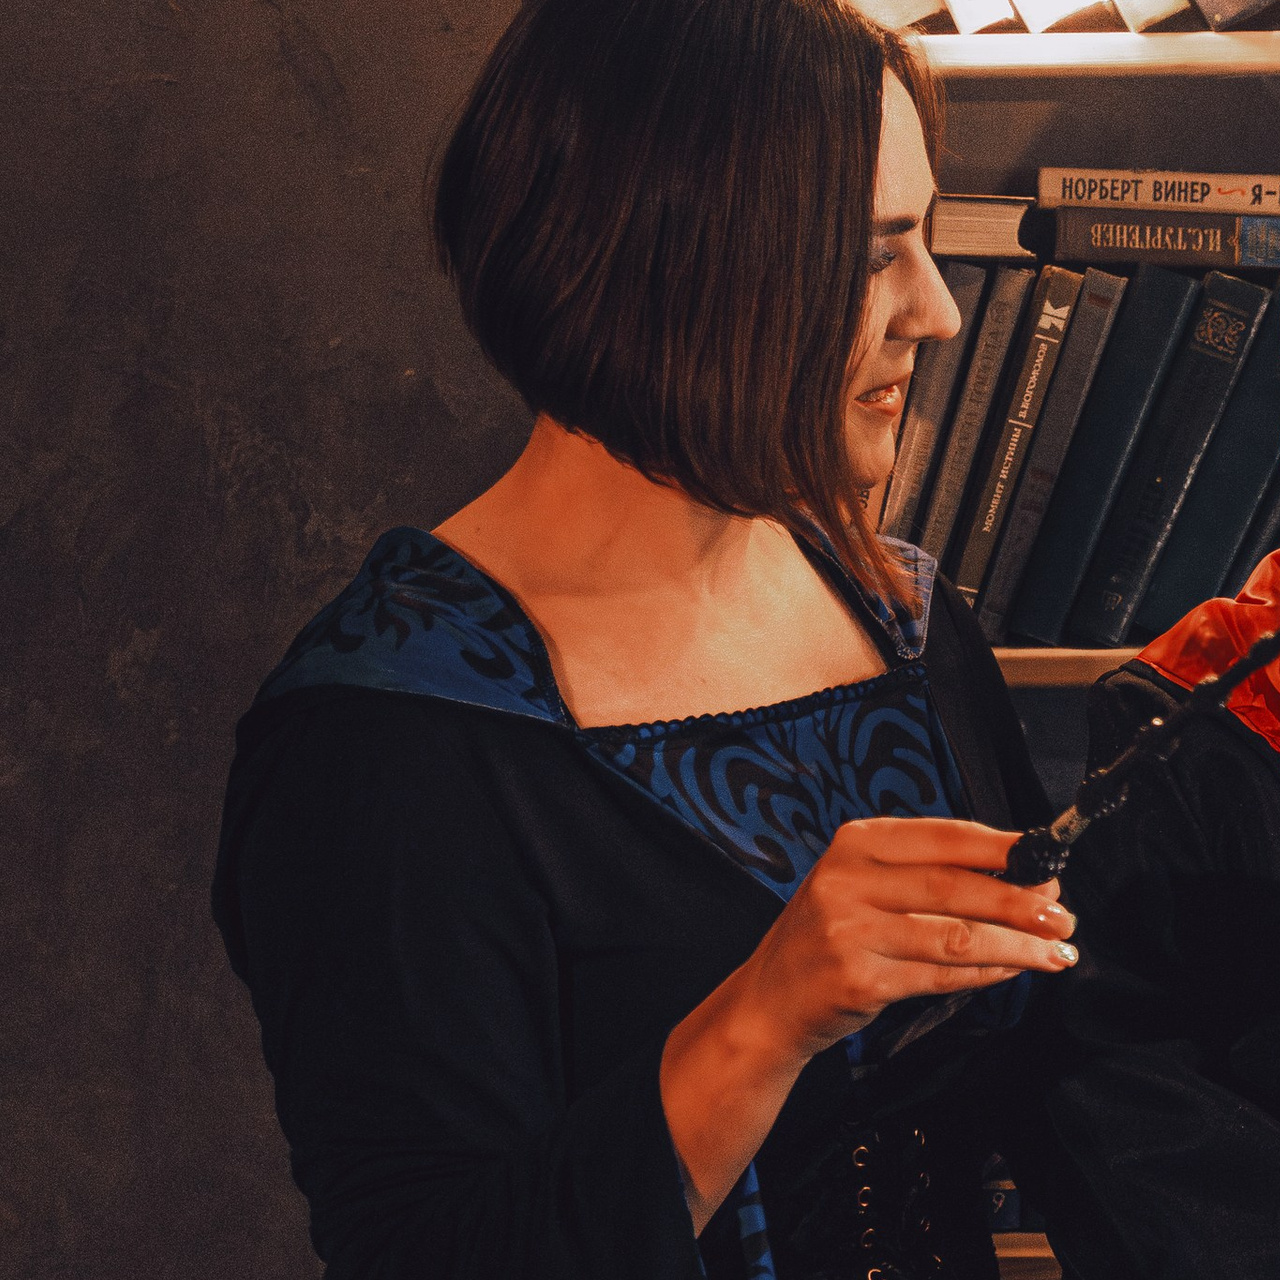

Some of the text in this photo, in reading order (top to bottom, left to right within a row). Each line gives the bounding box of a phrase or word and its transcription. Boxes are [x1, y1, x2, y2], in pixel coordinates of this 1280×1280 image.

[1062, 177, 1142, 202] НОРБЕРТ
[1153, 181, 1211, 203] ВИНЕР
[1090, 223, 1222, 252] И.С.ТУРГЕНЕВ
[1018, 343, 1049, 419] В.БОГОМОЛОВ
[984, 427, 1023, 532] МОМЕНТ ИСТИНЫ
